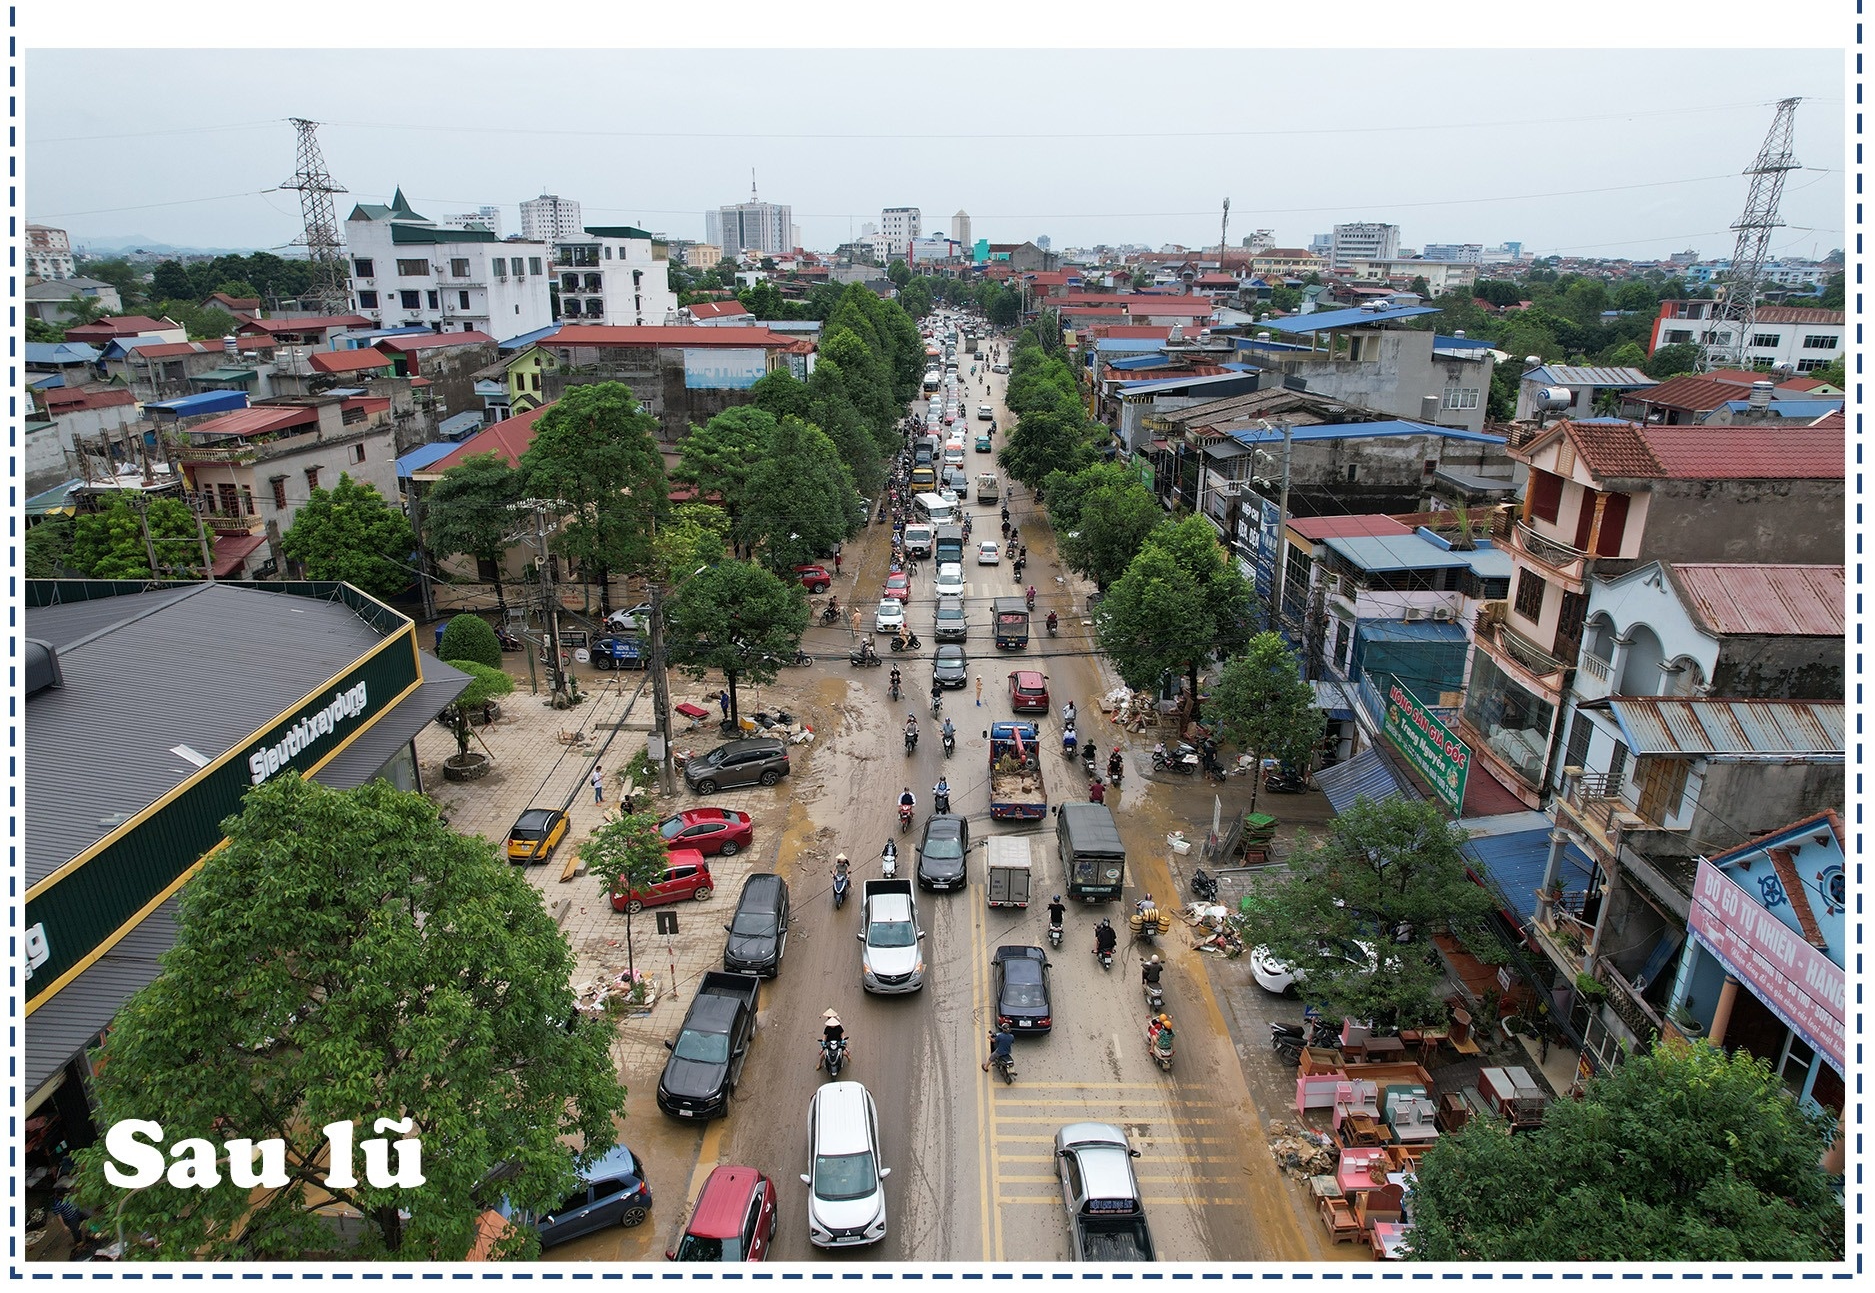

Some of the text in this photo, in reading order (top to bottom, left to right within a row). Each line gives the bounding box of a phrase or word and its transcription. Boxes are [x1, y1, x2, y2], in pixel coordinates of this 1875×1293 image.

[1390, 685, 1412, 716] NÔNG
[1412, 708, 1430, 733] SẢN
[1428, 725, 1445, 750] GIÁ
[1444, 740, 1466, 770] GỐC
[1402, 718, 1420, 745] Trang
[1705, 872, 1720, 902] ĐỒ
[1740, 902, 1758, 936] TỰ
[1756, 918, 1797, 968] NHIÊN
[1805, 958, 1845, 1012] HÀNG
